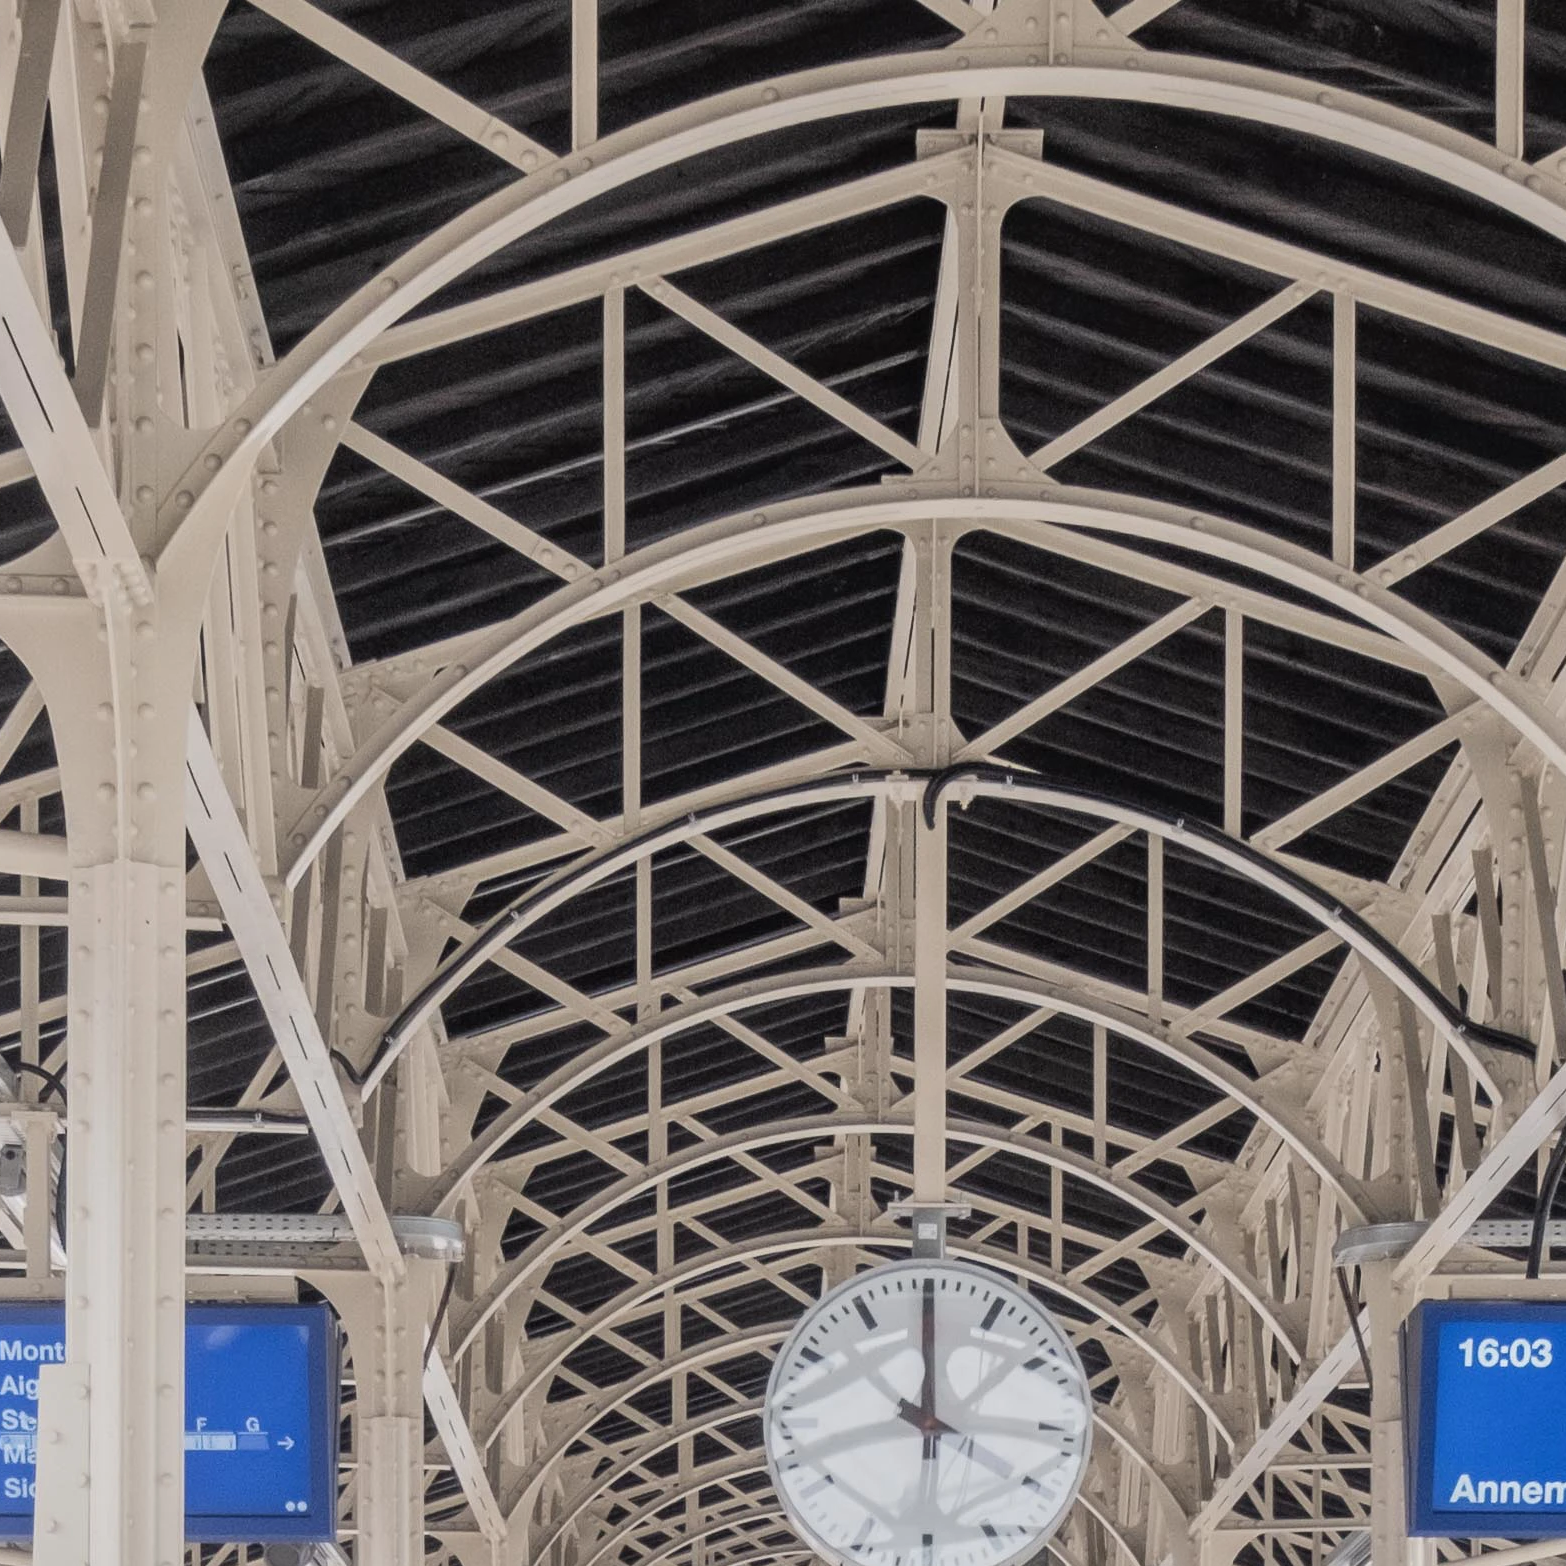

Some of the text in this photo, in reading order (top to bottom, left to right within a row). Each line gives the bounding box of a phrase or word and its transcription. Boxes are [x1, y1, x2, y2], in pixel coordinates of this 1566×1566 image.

[0, 1340, 65, 1361] Mont
[1459, 1338, 1553, 1368] 16:03
[197, 1417, 259, 1432] F G
